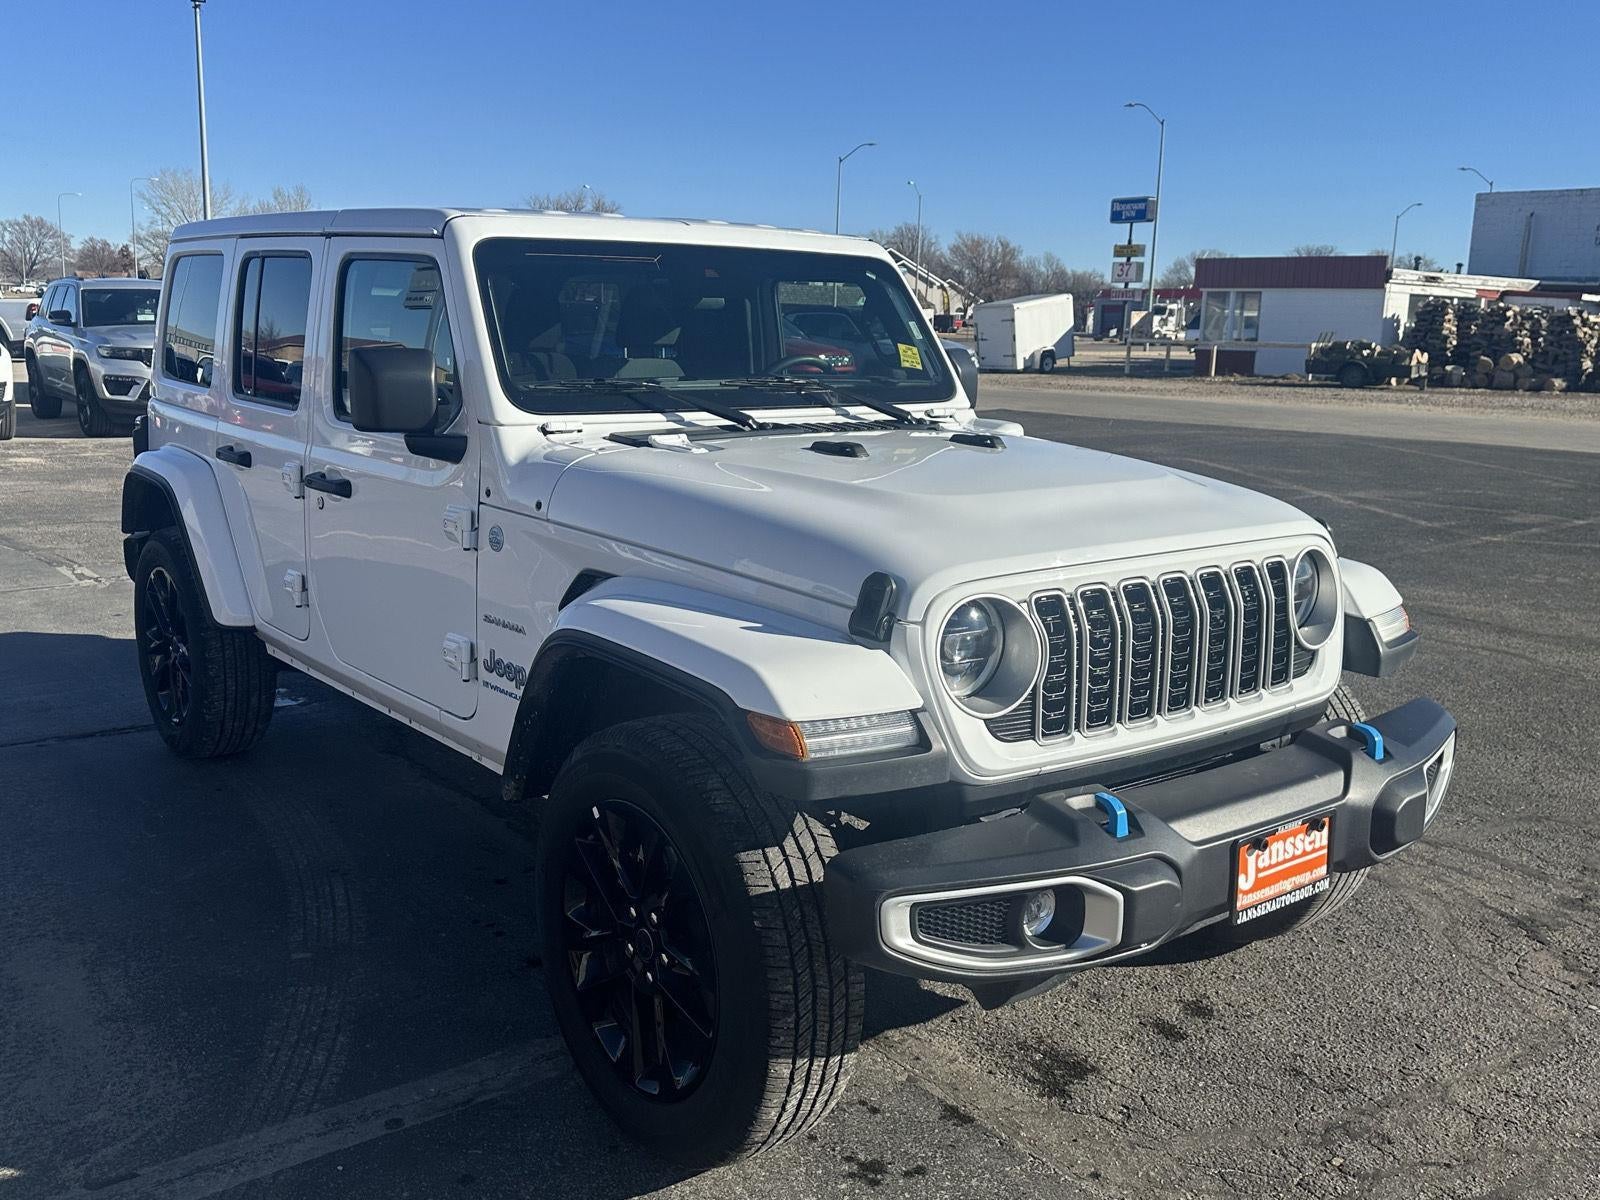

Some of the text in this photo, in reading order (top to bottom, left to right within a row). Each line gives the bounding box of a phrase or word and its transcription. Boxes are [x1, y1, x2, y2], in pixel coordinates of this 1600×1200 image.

[1117, 263, 1132, 277] 37
[483, 648, 527, 690] Jeep
[1238, 828, 1329, 891] Janssen
